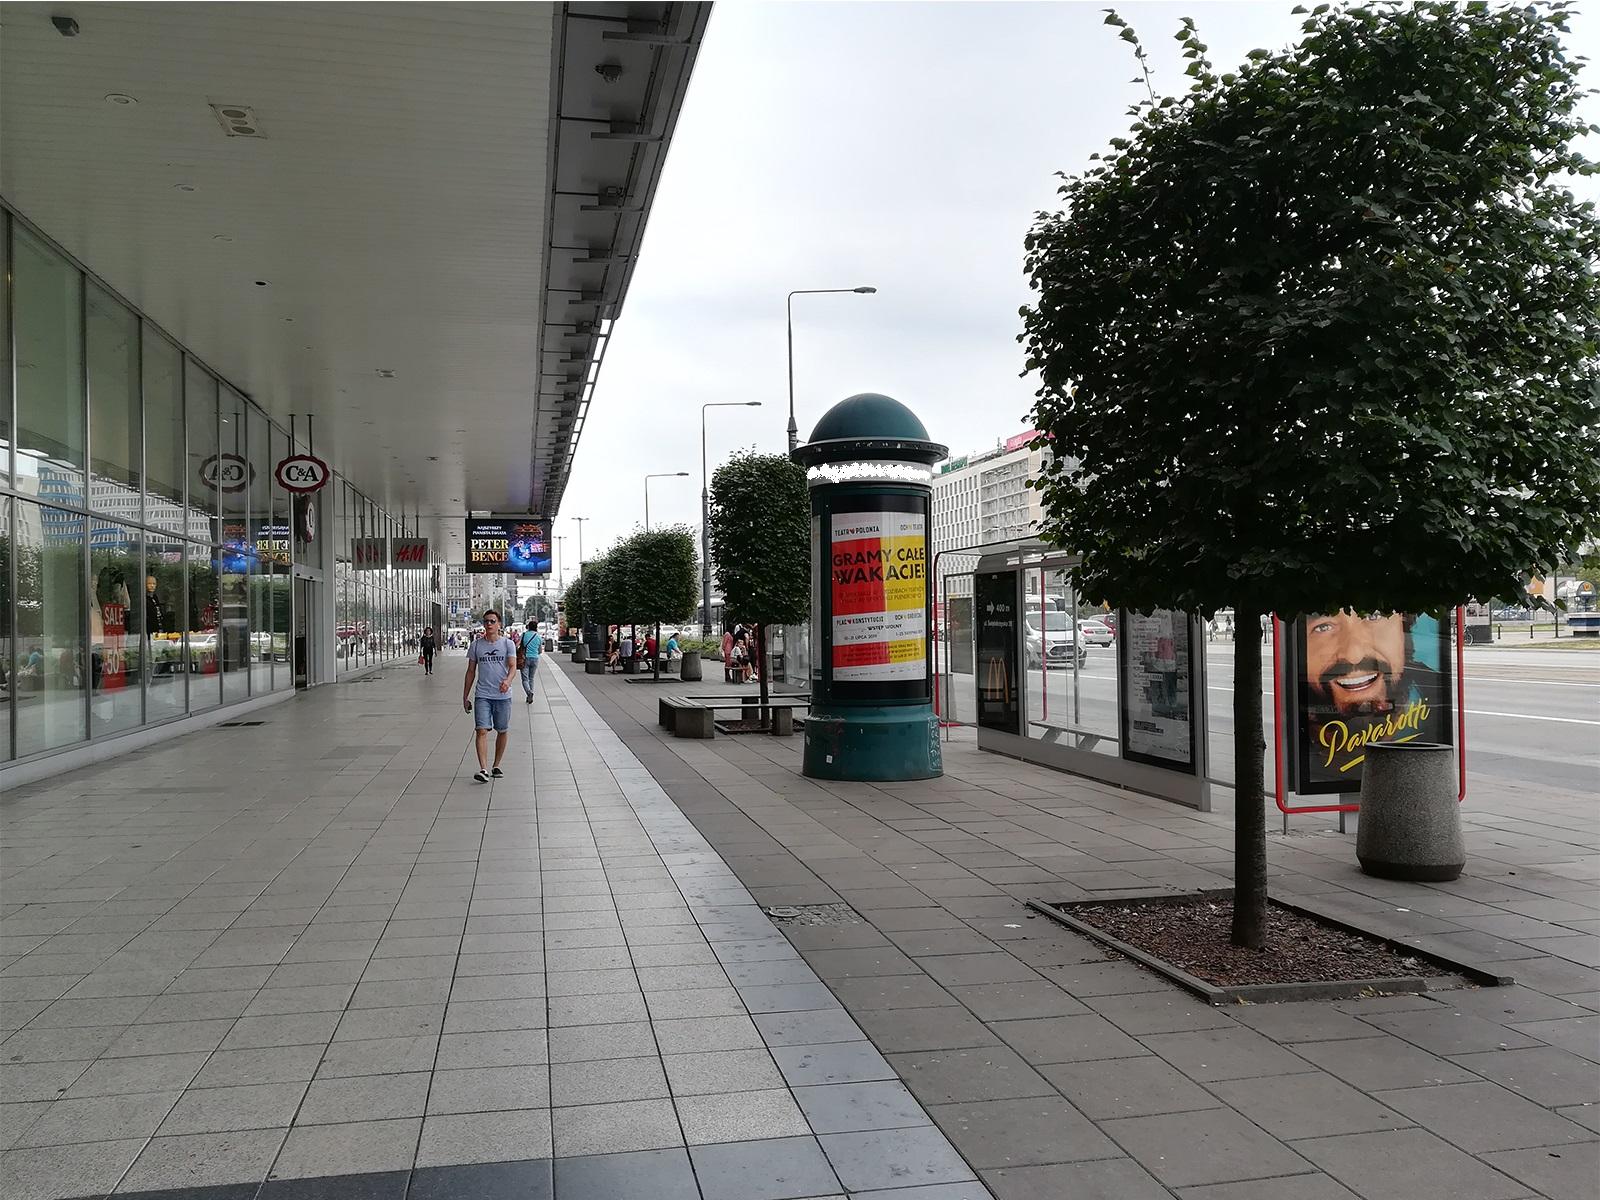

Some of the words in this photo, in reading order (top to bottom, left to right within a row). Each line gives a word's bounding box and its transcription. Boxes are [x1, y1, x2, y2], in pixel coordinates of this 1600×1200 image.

[286, 465, 319, 481] C&A
[395, 544, 426, 562] H&M
[471, 539, 509, 549] PETER
[471, 551, 509, 562] BENCE
[833, 549, 892, 567] GRAMY
[897, 547, 925, 562] CAŁE
[833, 563, 925, 585] WAKACJE!
[104, 606, 124, 626] SALE
[1319, 698, 1431, 768] Pavarotti
